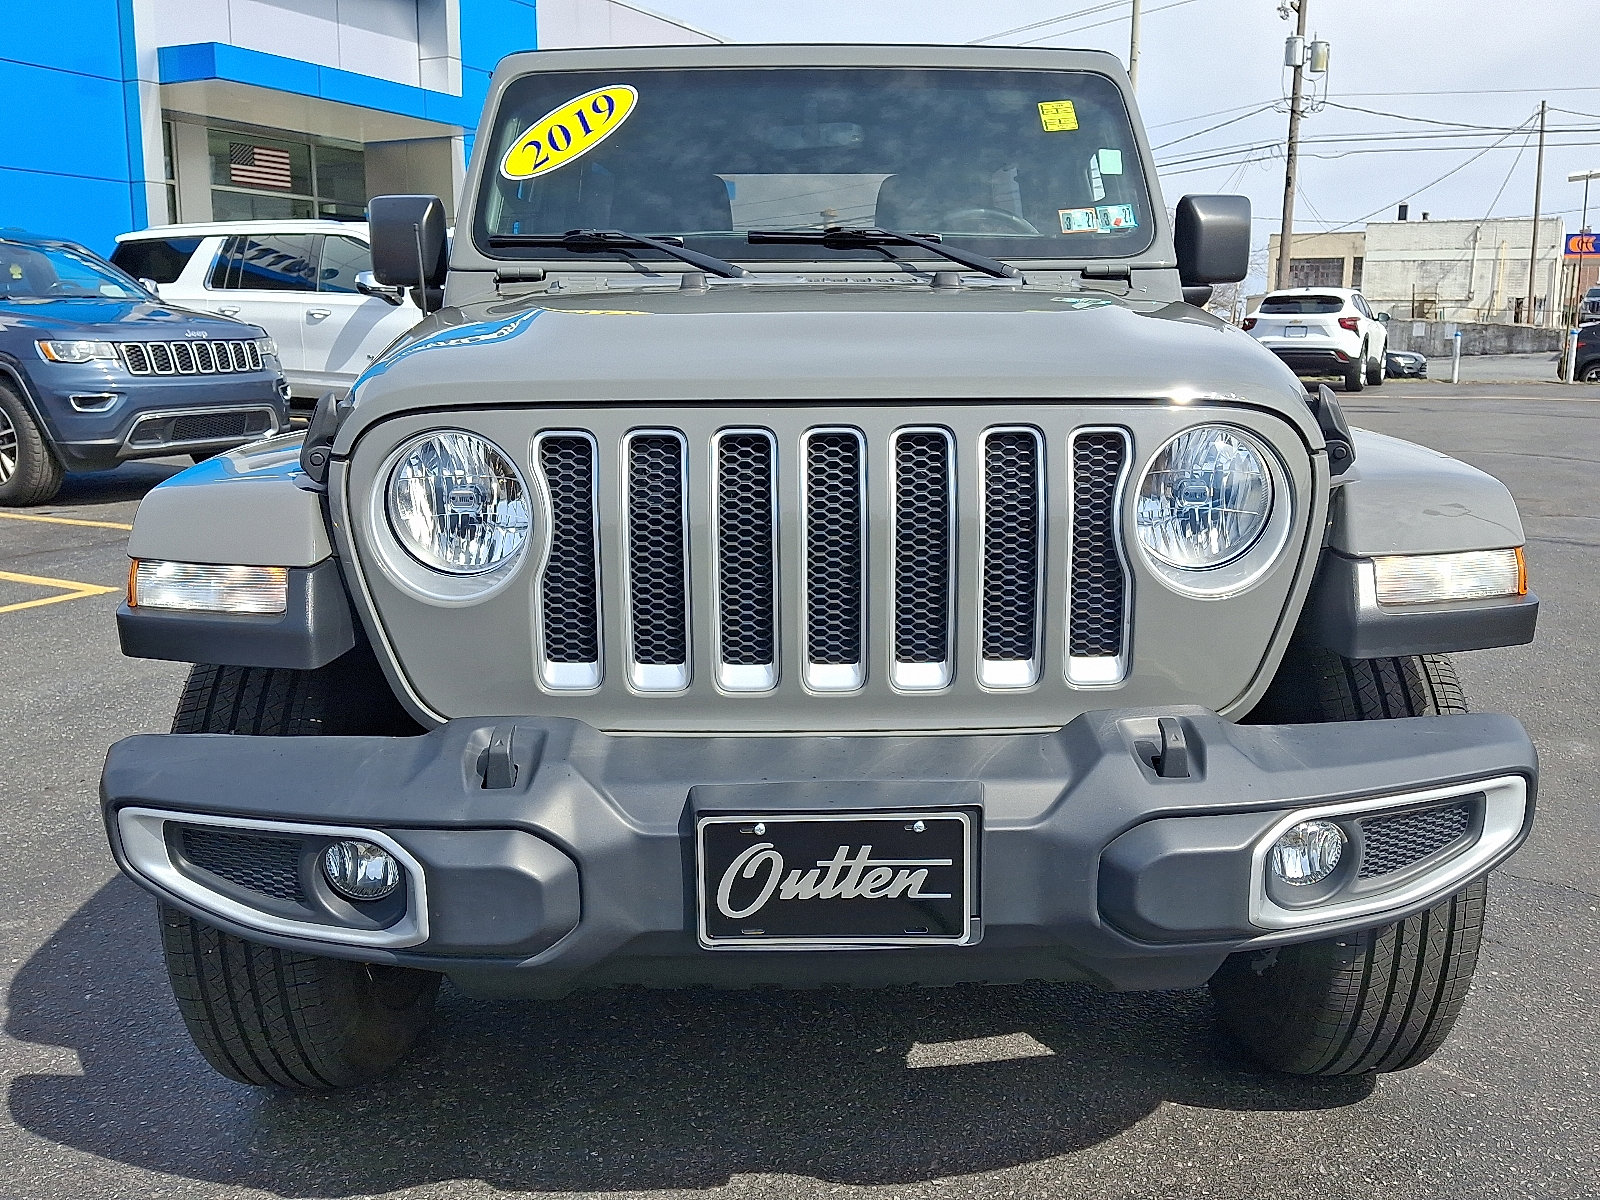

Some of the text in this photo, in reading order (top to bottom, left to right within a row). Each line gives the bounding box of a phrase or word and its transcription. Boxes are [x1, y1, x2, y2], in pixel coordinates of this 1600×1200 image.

[521, 94, 616, 171] 2019
[185, 328, 208, 339] Jeep
[717, 842, 953, 919] Outten
